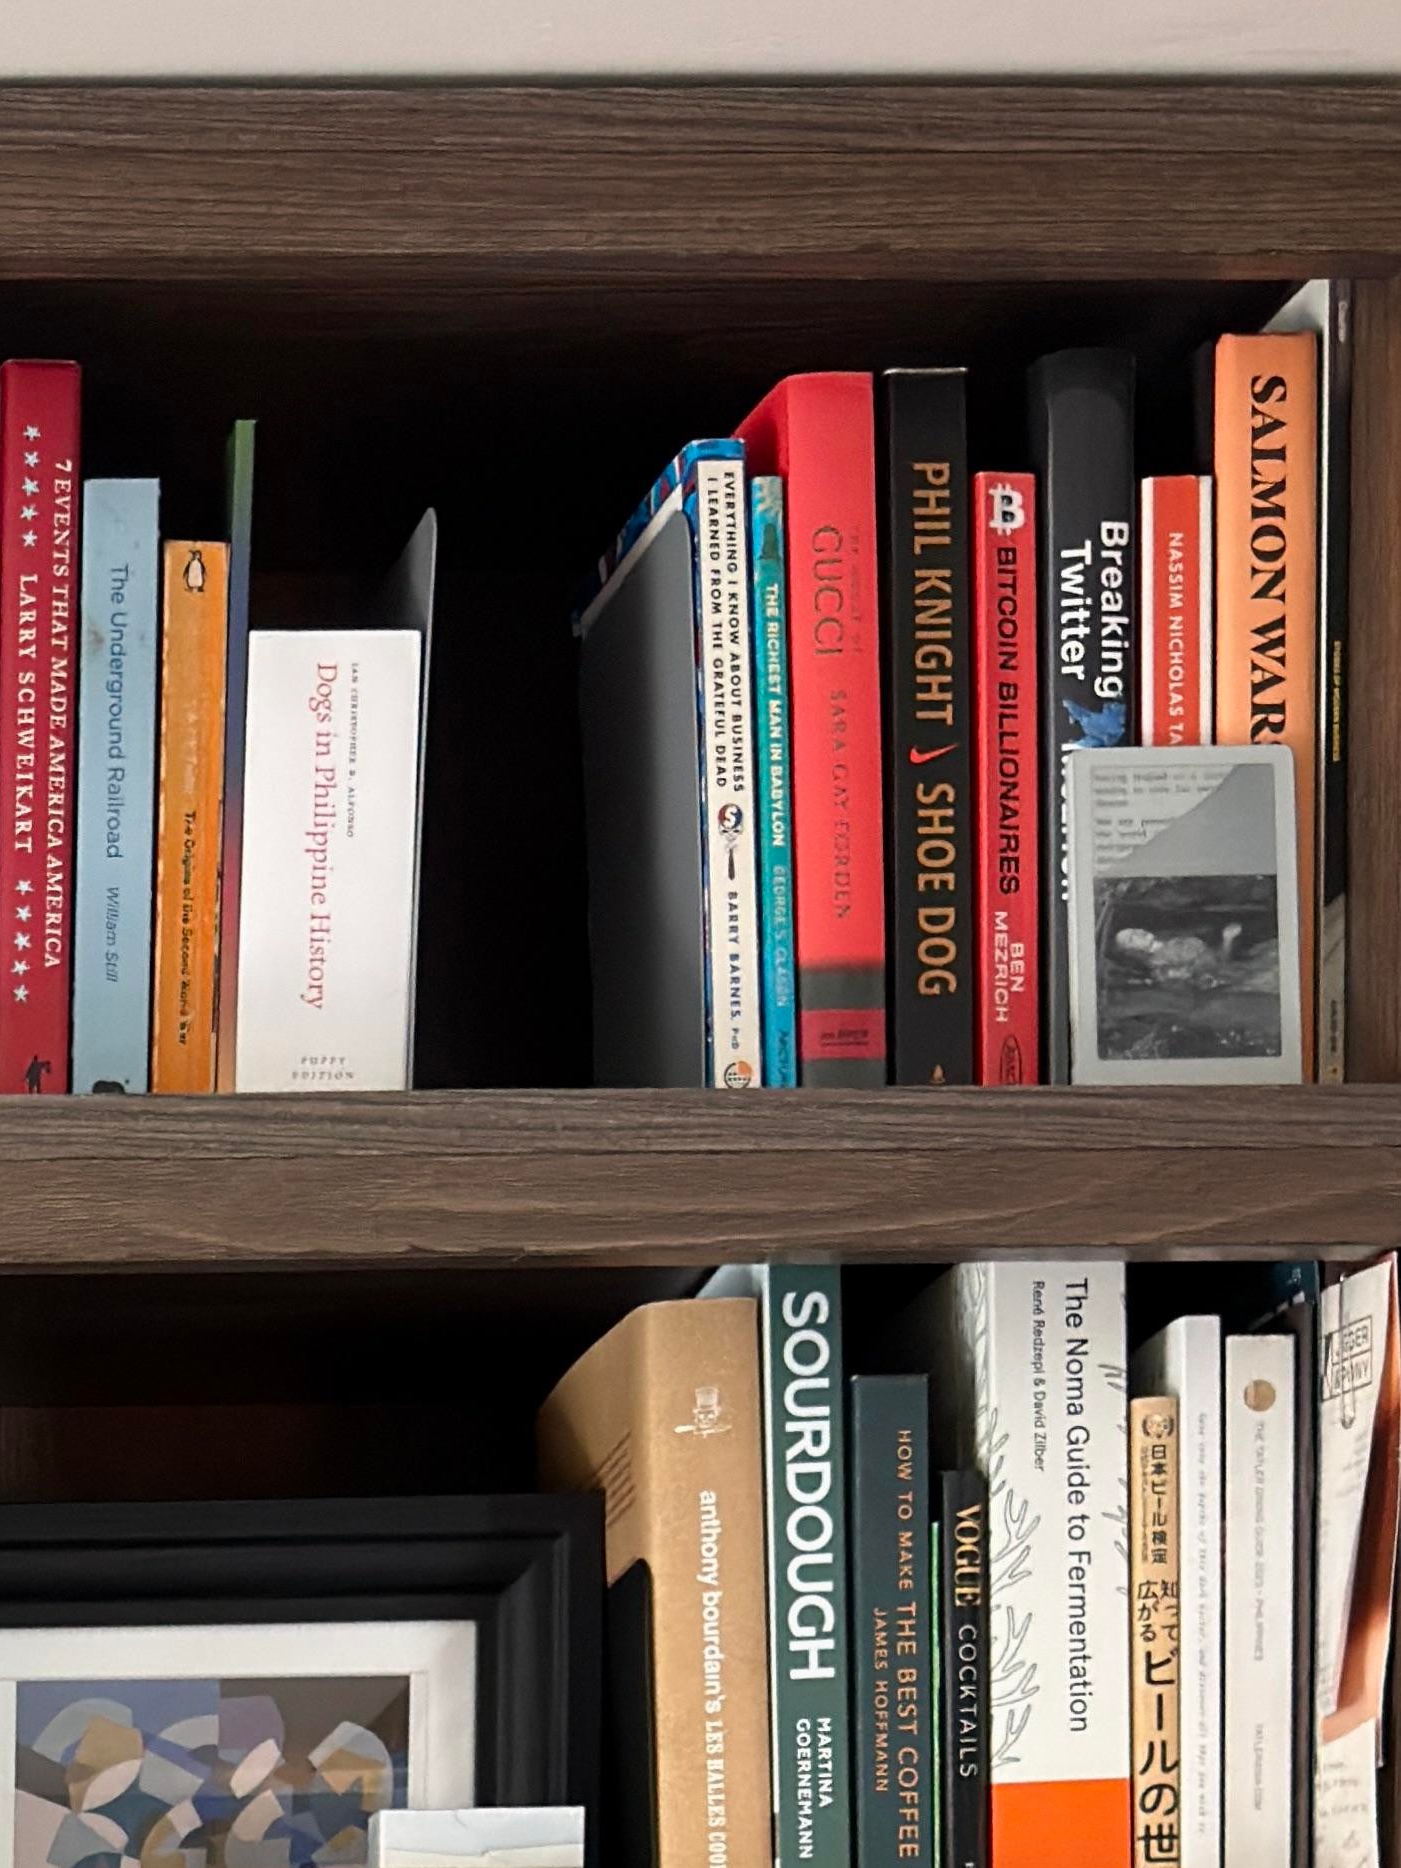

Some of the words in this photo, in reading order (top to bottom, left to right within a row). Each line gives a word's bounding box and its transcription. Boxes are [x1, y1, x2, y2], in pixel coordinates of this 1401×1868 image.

[911, 461, 951, 553] PHIL
[108, 564, 125, 605] The
[997, 547, 1018, 670] BITCOIN
[1059, 540, 1092, 682] Twitter
[1094, 520, 1130, 699] Breaking
[104, 611, 125, 759] Underground
[307, 663, 337, 722] Dogs
[914, 567, 955, 727] KNIGHT
[318, 729, 331, 754] in
[998, 679, 1020, 895] BILLIONAIRES
[106, 764, 123, 859] Railroad
[303, 765, 337, 906] Philippine
[916, 783, 957, 893] SHOE
[300, 911, 331, 1012] History
[918, 905, 959, 999] DOG
[1064, 1278, 1089, 1333] The
[1065, 1338, 1085, 1416] Noma
[782, 1290, 836, 1681] SOURDOUGH
[1066, 1421, 1084, 1504] Guide
[955, 1504, 982, 1608] VOGUE
[1067, 1510, 1084, 1537] to
[1067, 1545, 1088, 1732] Fermentation
[958, 1624, 978, 1777] COCKTAILS
[795, 1719, 813, 1859] GOERNEMANN
[816, 1718, 833, 1808] MARTINA
